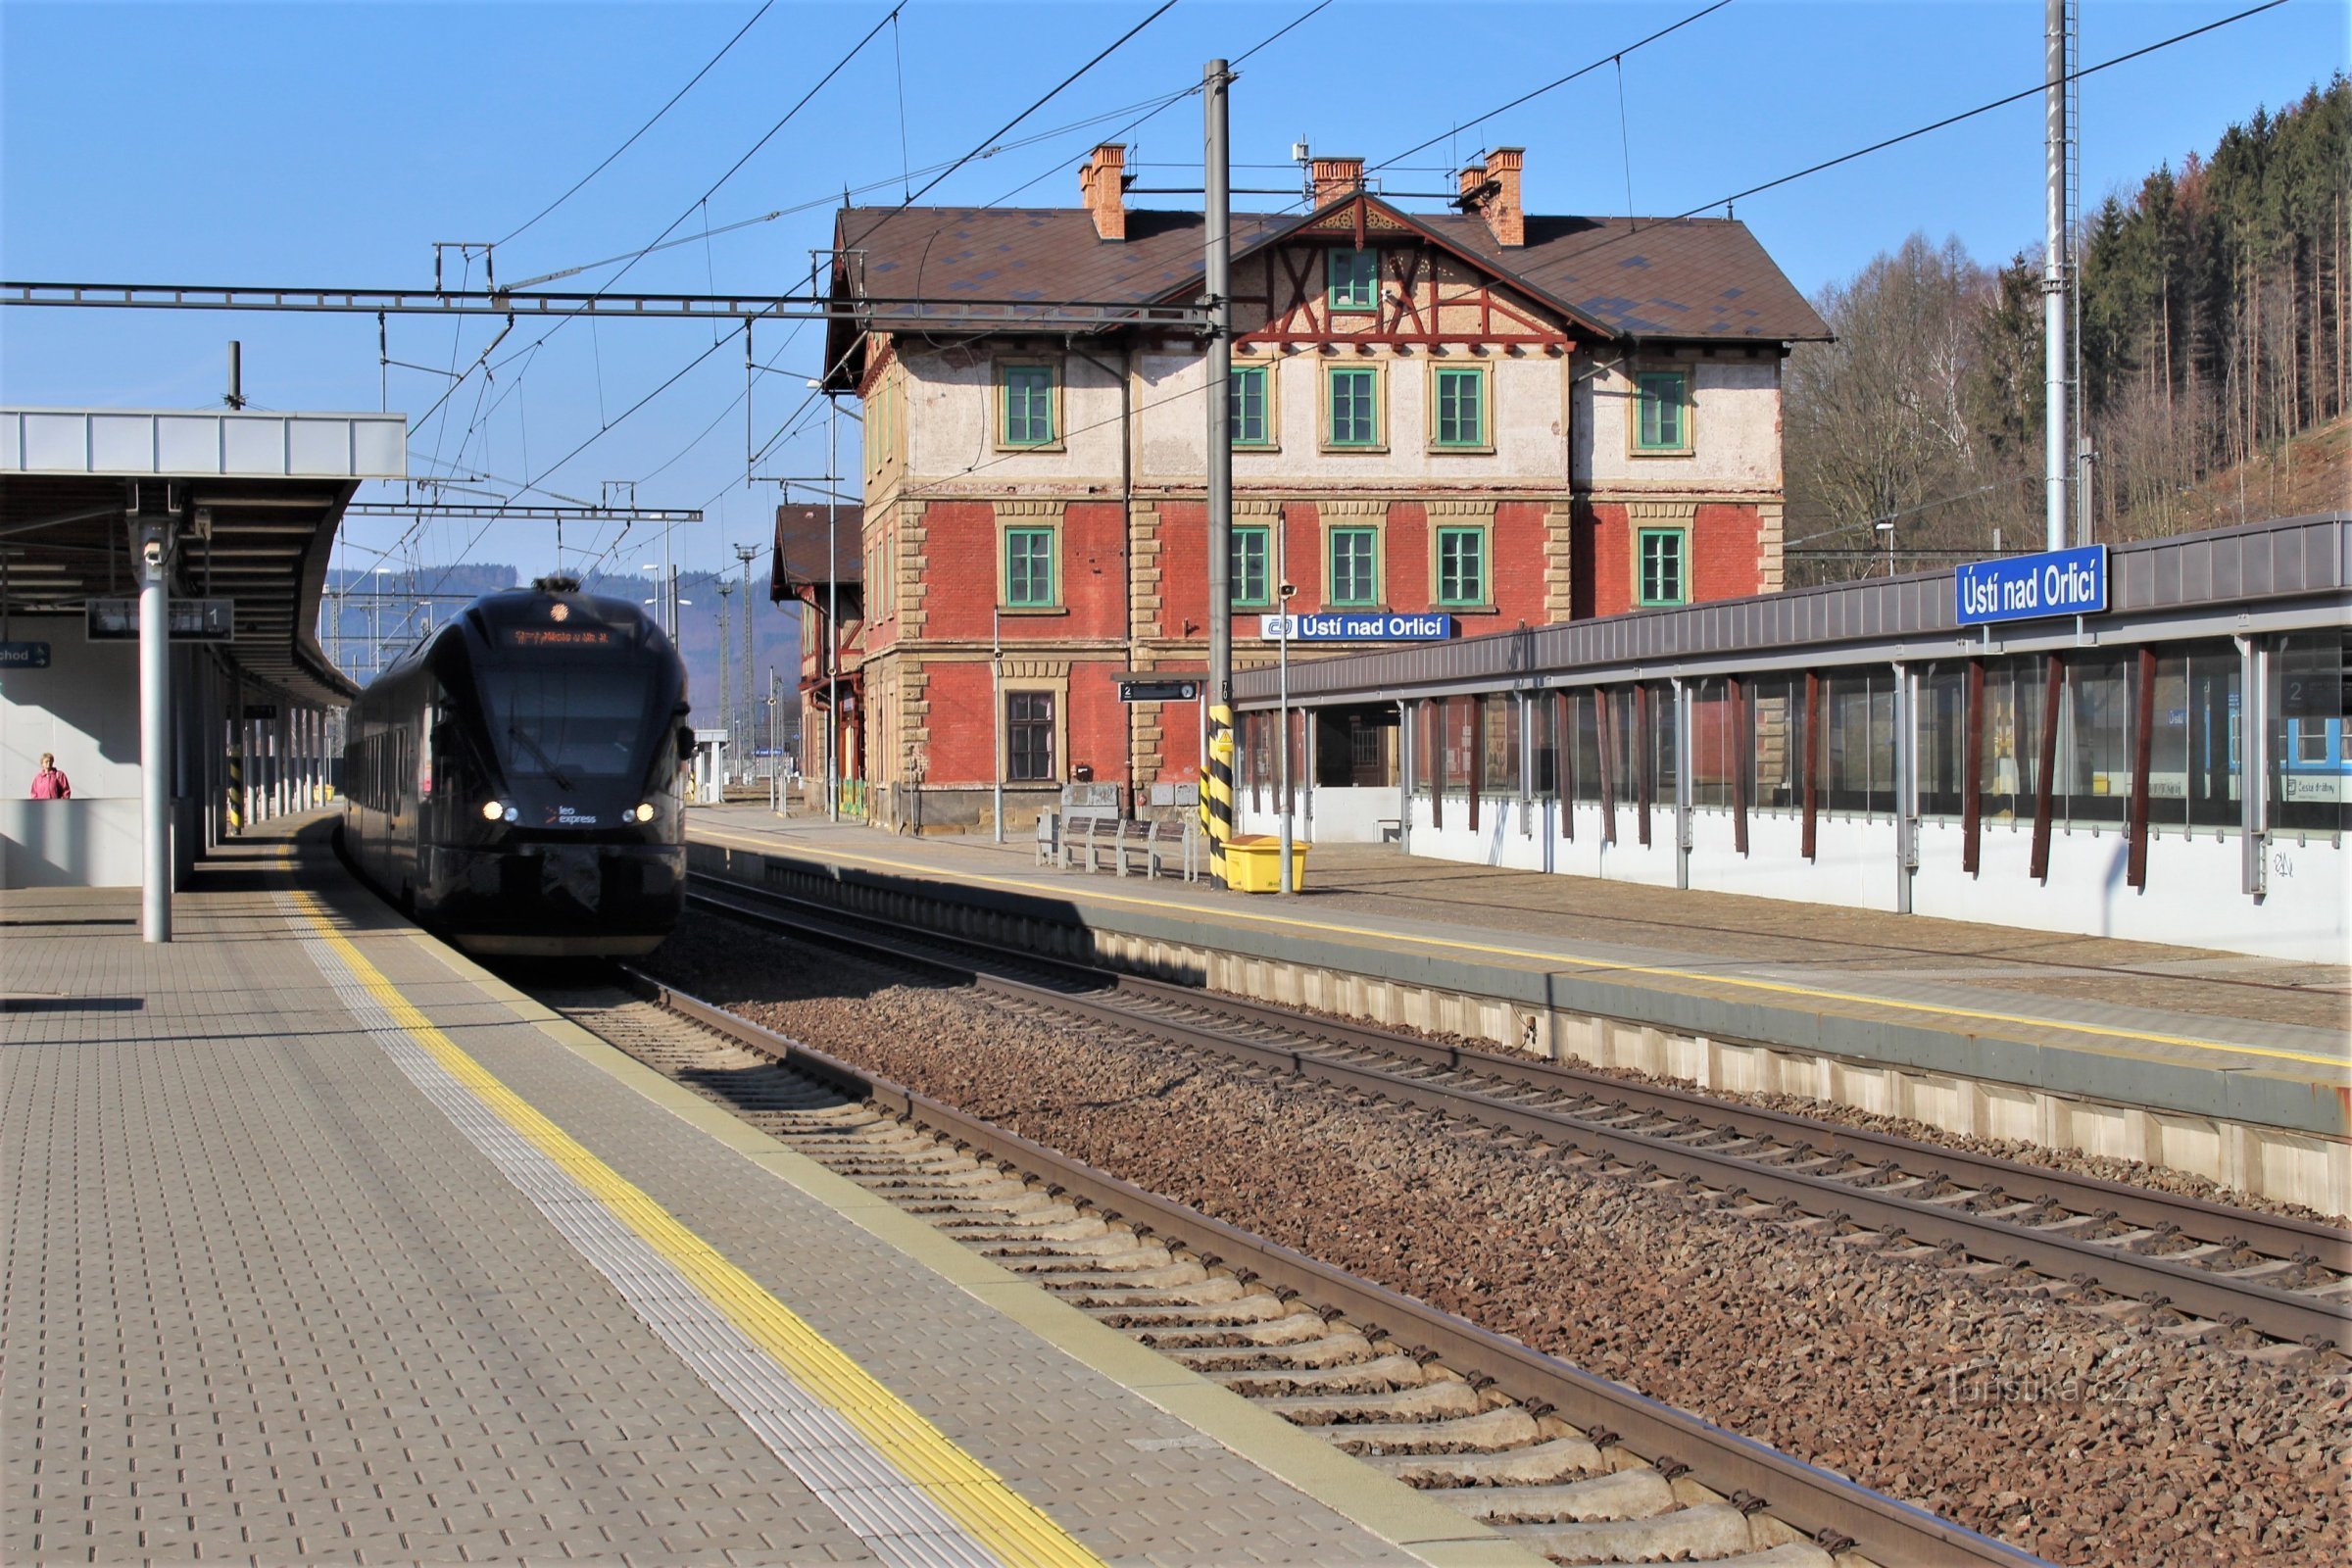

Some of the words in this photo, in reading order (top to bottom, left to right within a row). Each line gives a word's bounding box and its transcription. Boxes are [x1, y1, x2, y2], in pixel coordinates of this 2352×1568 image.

[1964, 565, 1999, 614] Ústí
[2003, 567, 2037, 611] nad
[2044, 559, 2095, 606] Orlicí
[209, 608, 218, 625] 1
[1302, 613, 1343, 635] Ústí
[1348, 617, 1383, 635] nad
[1389, 616, 1443, 635] Orlicí
[1124, 687, 1131, 696] 2
[559, 815, 597, 825] express
